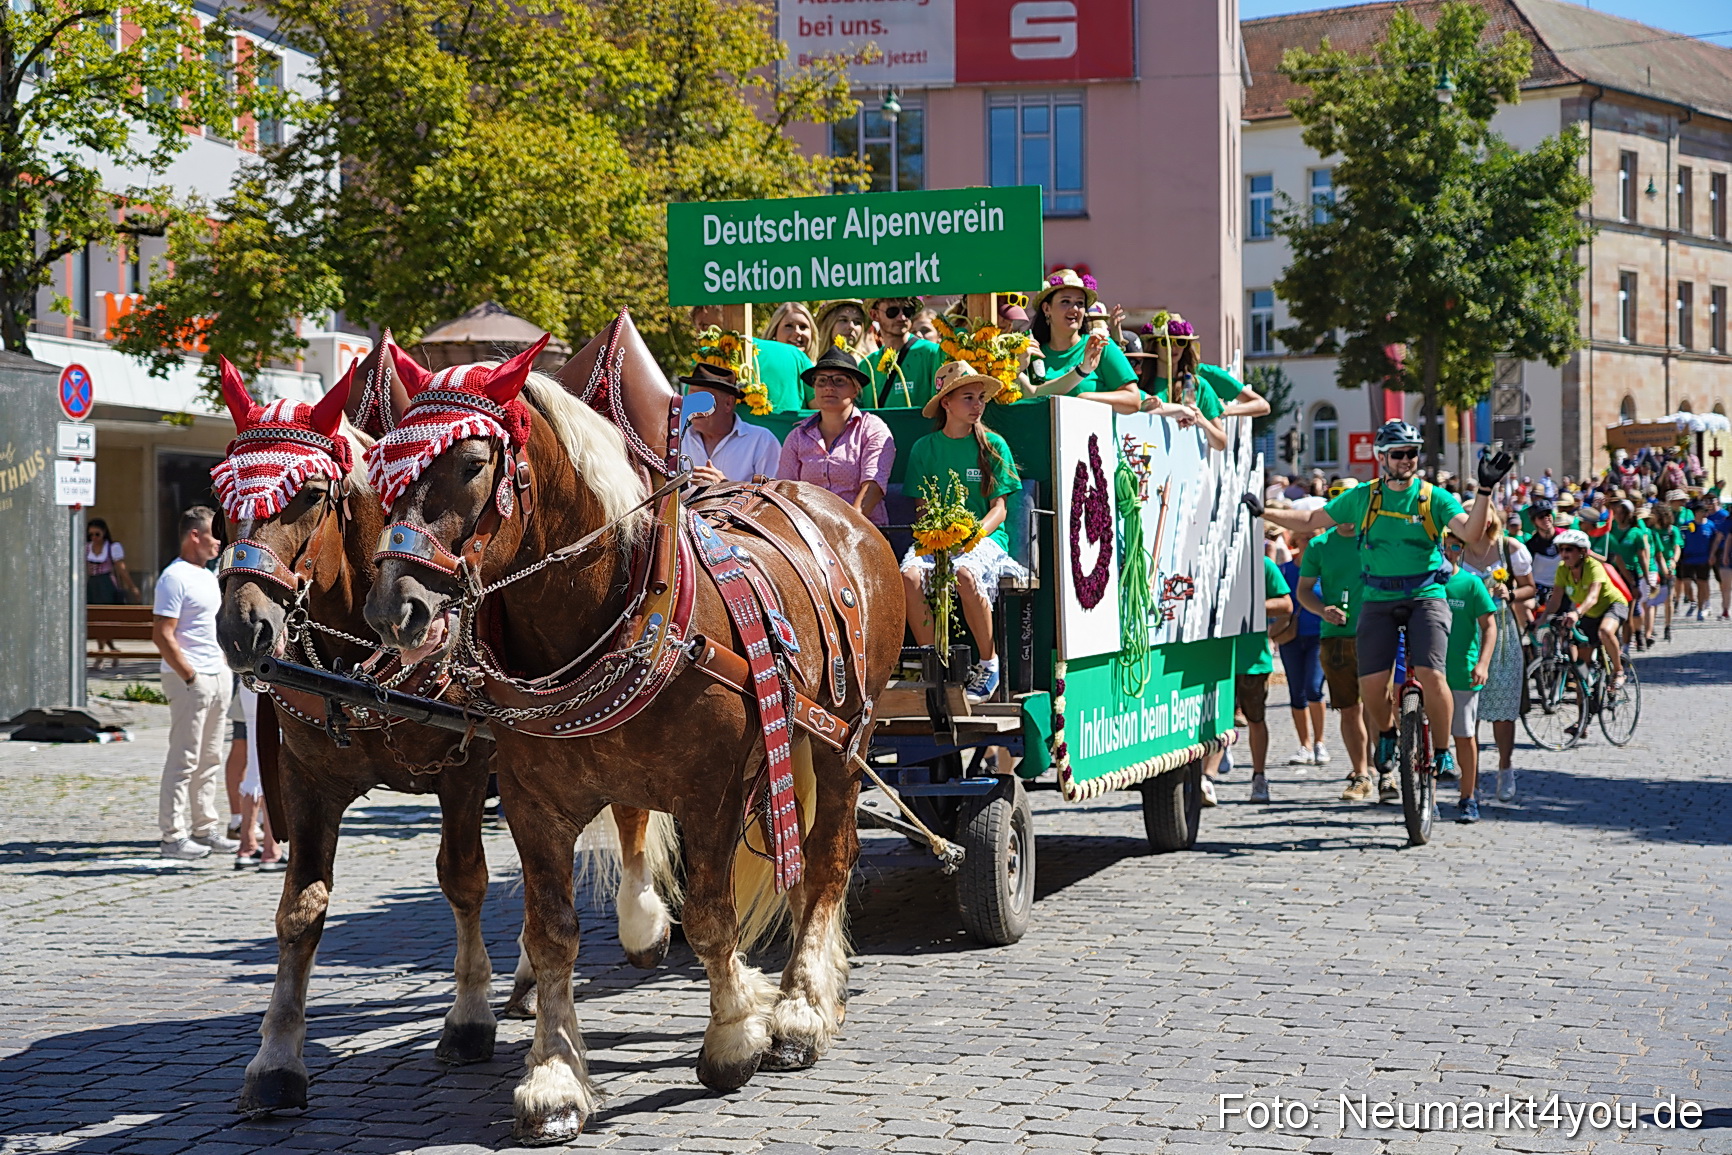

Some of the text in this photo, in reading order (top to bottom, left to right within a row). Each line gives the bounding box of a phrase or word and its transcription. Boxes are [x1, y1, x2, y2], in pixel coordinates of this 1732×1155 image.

[798, 15, 889, 37] bei uns.
[887, 50, 928, 68] jetzt!
[703, 199, 1005, 246] Deutscher Alpenverein
[703, 251, 940, 293] Sektion Neumarkt
[1079, 682, 1220, 760] Inklusion beim Bergsport
